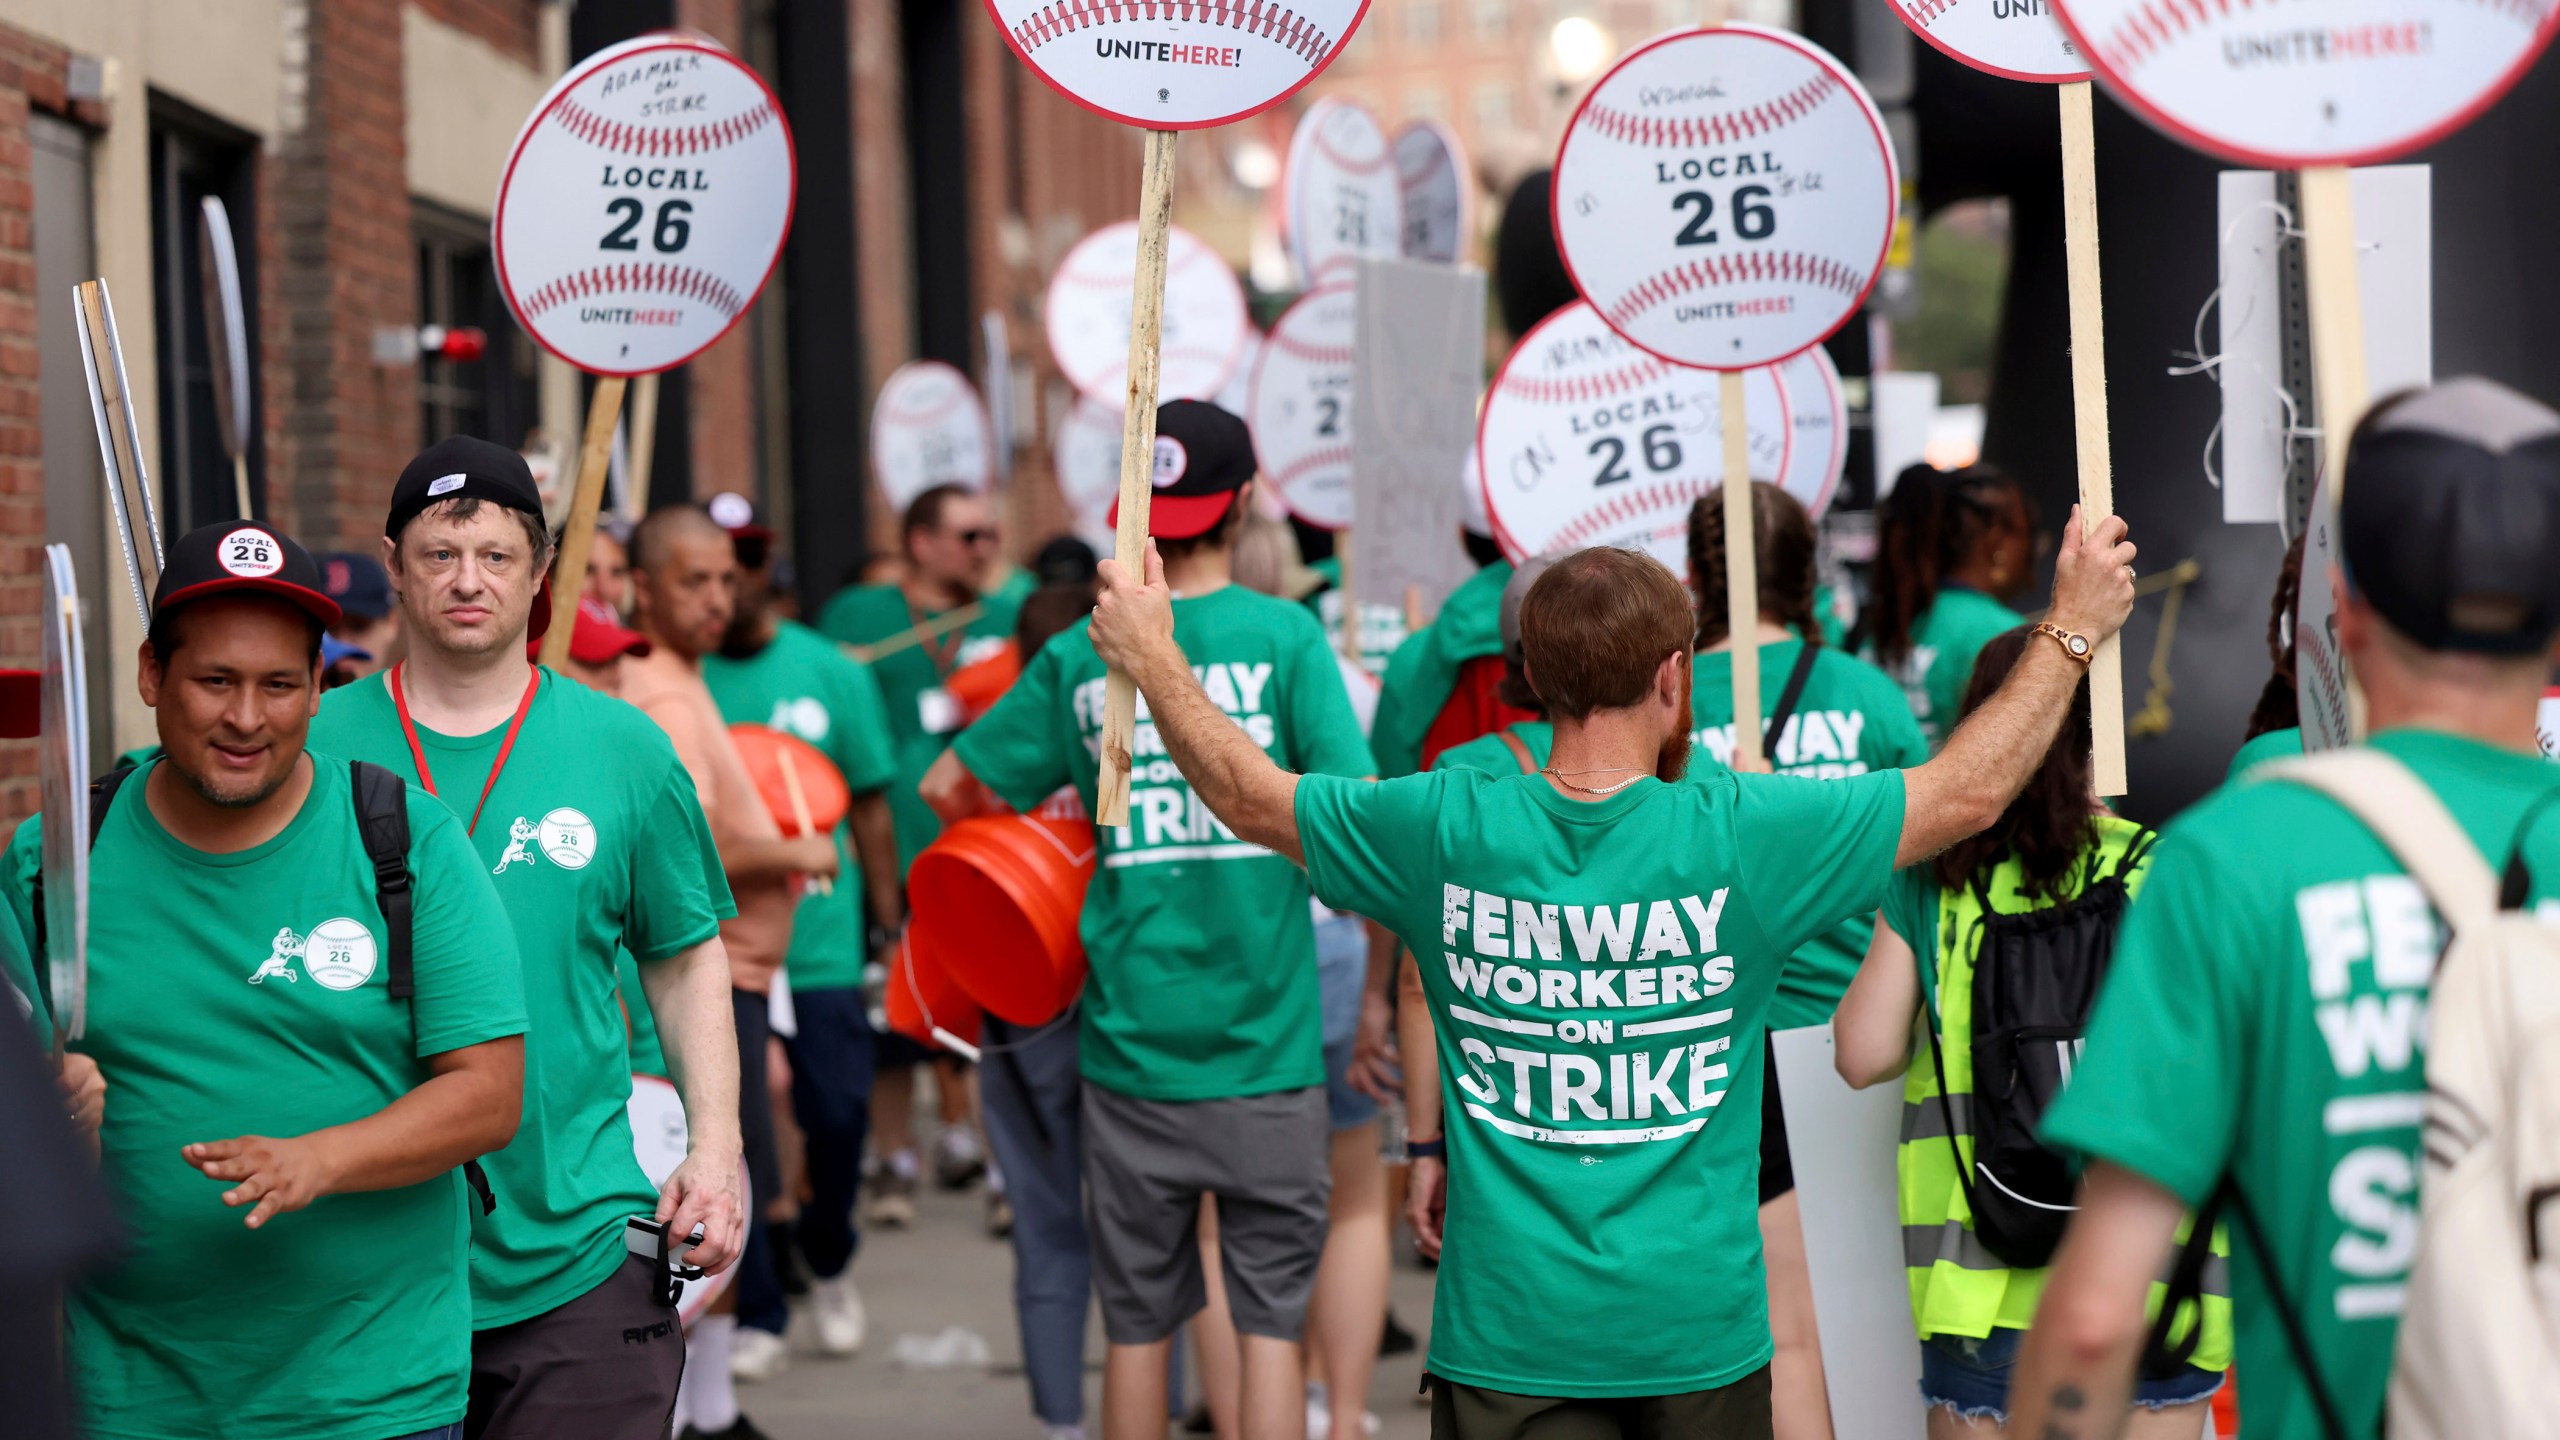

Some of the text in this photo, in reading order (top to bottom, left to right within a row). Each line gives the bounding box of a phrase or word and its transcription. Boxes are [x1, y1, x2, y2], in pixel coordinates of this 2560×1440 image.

[1993, 0, 2051, 20] UNIT
[1096, 38, 1241, 68] UNITEHERE!
[2222, 20, 2432, 68] UNITEHERE!
[601, 55, 701, 99] ARAMARK
[602, 165, 709, 191] LOCAL
[1656, 151, 1782, 183] LOCAL
[600, 197, 694, 255] 26
[1671, 184, 1776, 247] 26
[580, 307, 683, 327] UNITEHERE!
[1675, 295, 1795, 323] UNITEHERE!
[1315, 396, 1343, 437] 2
[1571, 391, 1686, 436] LOCAL
[1588, 422, 1683, 488] 26
[229, 536, 273, 548] LOCAL
[233, 546, 268, 563] 26
[560, 834, 578, 846] 26
[1443, 882, 1730, 962] FENWAY
[329, 950, 351, 963] 26
[1444, 950, 1735, 1008] WORKERS
[1556, 1019, 1613, 1044] ON
[1456, 1035, 1731, 1121] STRIKE
